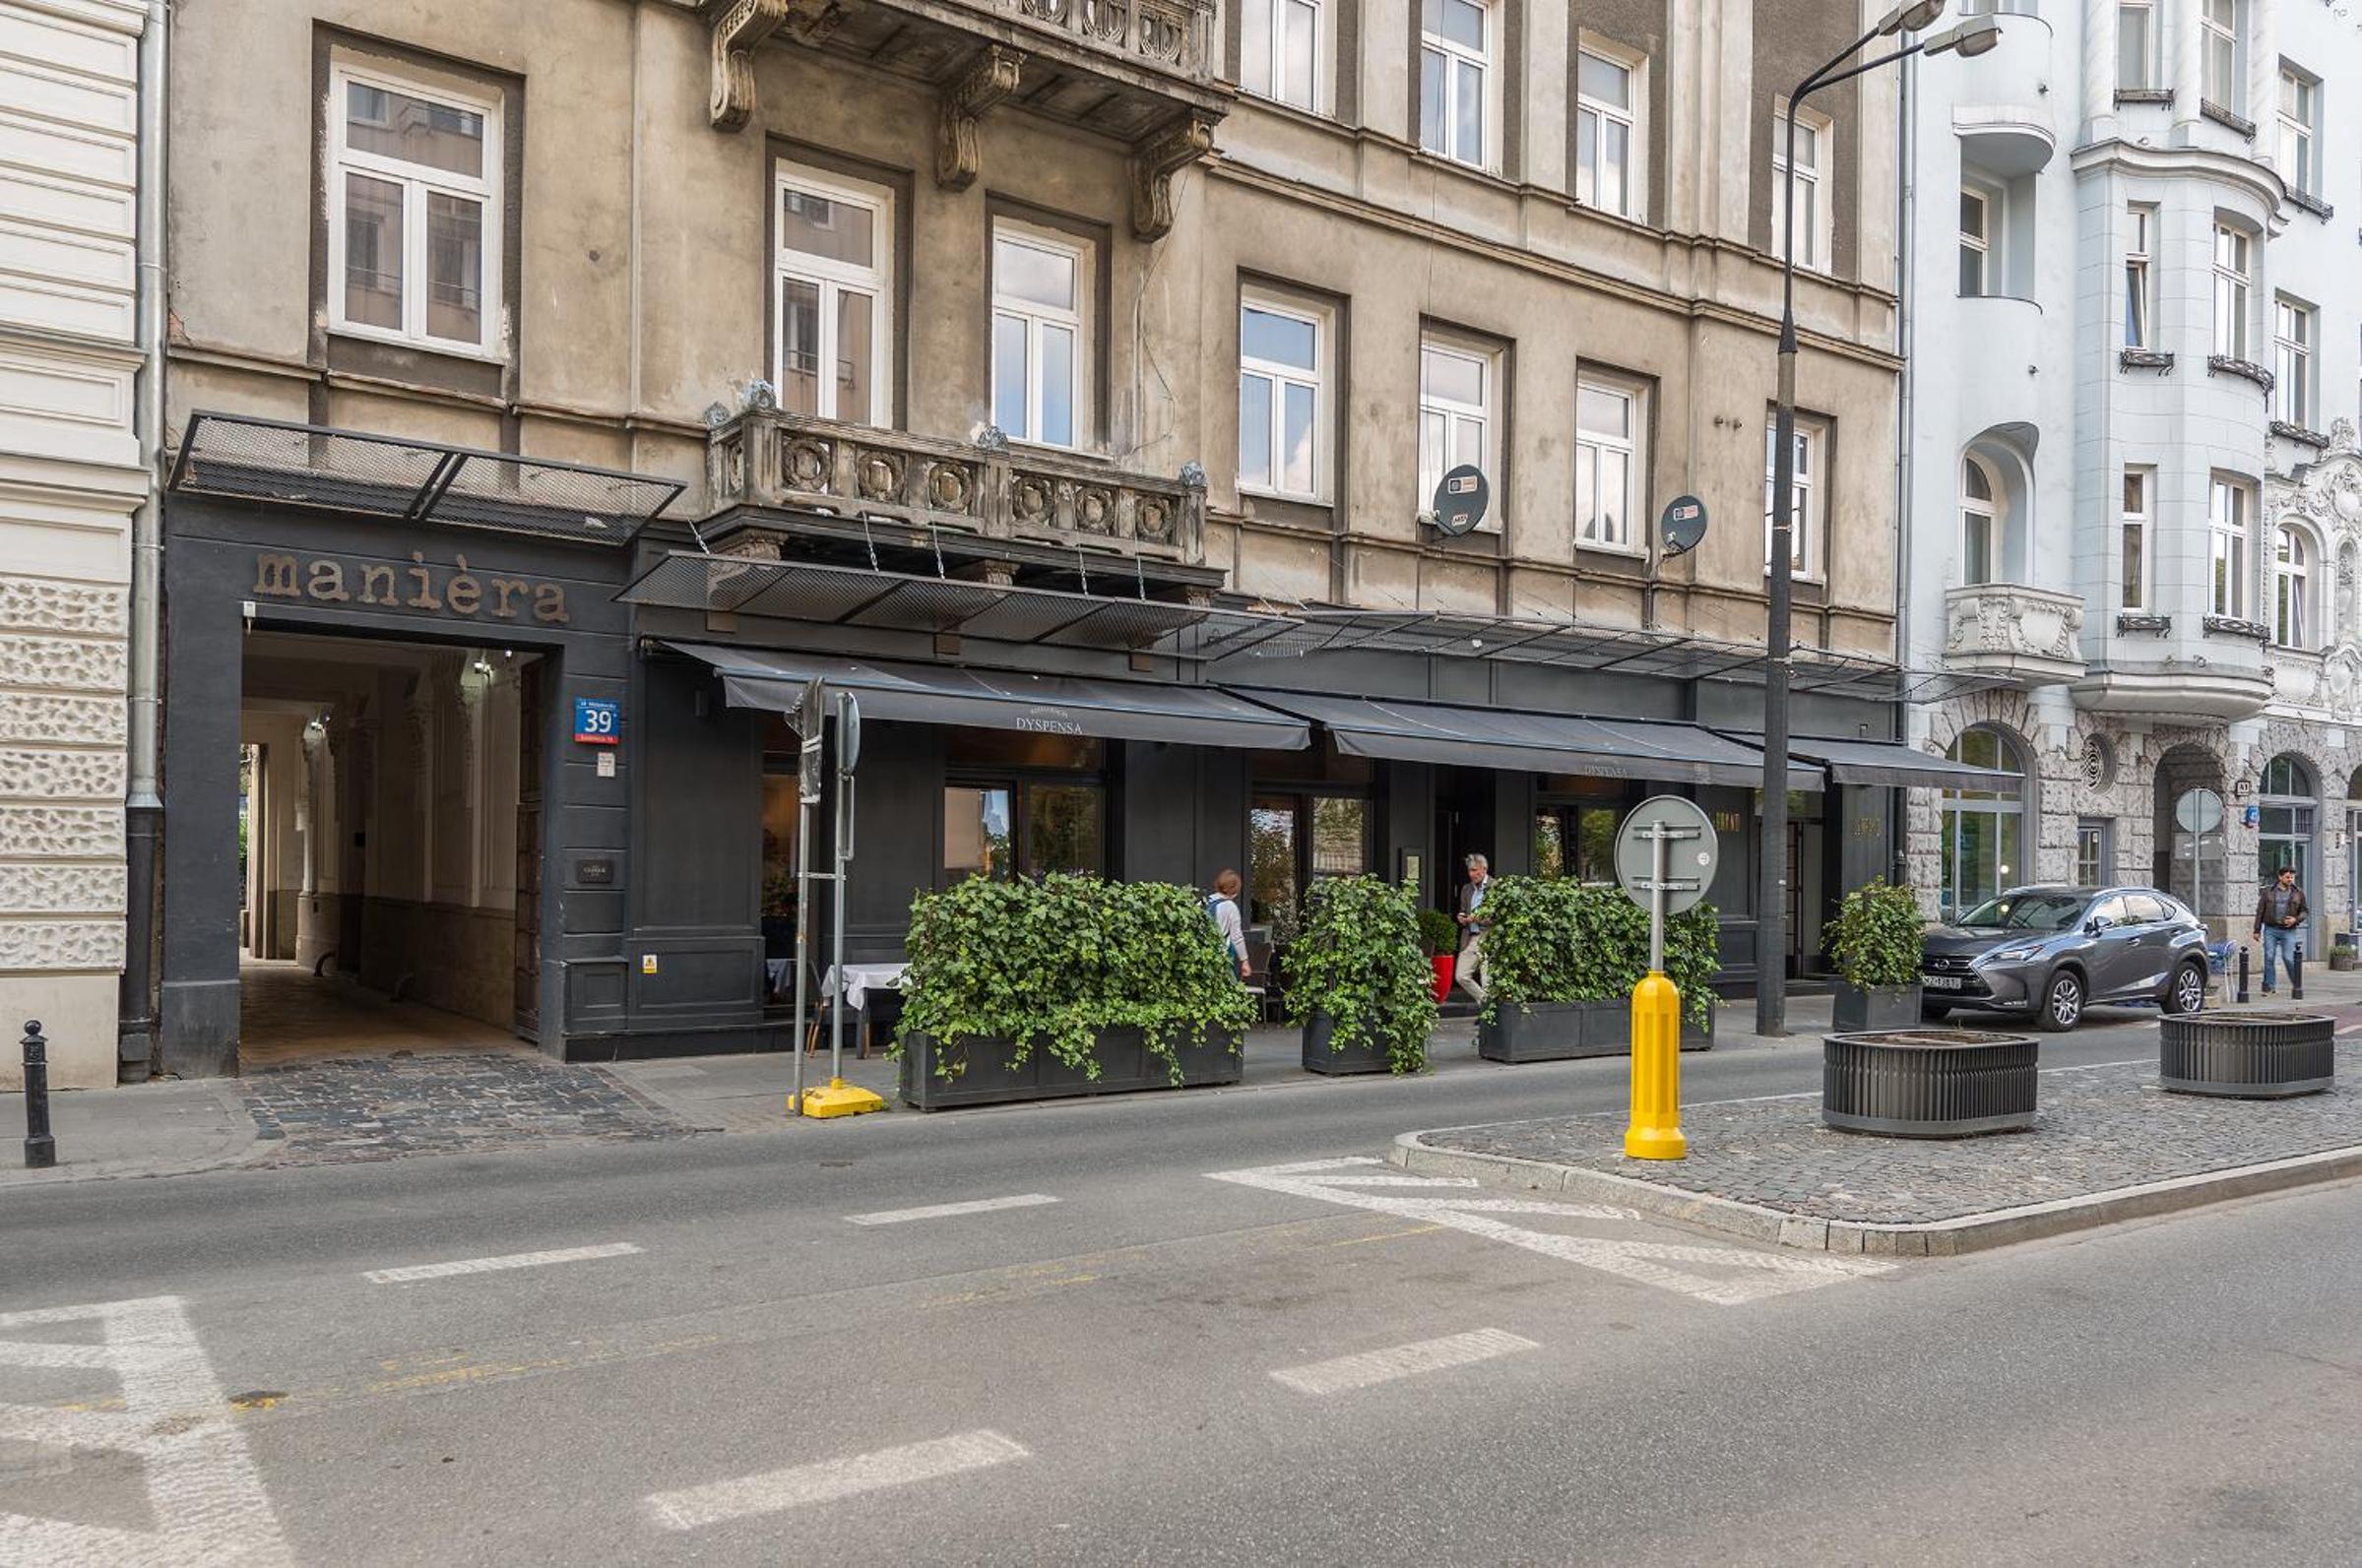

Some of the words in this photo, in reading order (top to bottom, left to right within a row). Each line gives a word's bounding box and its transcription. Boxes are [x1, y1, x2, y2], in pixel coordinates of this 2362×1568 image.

[253, 550, 570, 623] manièra
[585, 709, 612, 733] 39
[1016, 717, 1083, 735] DYSPENSA
